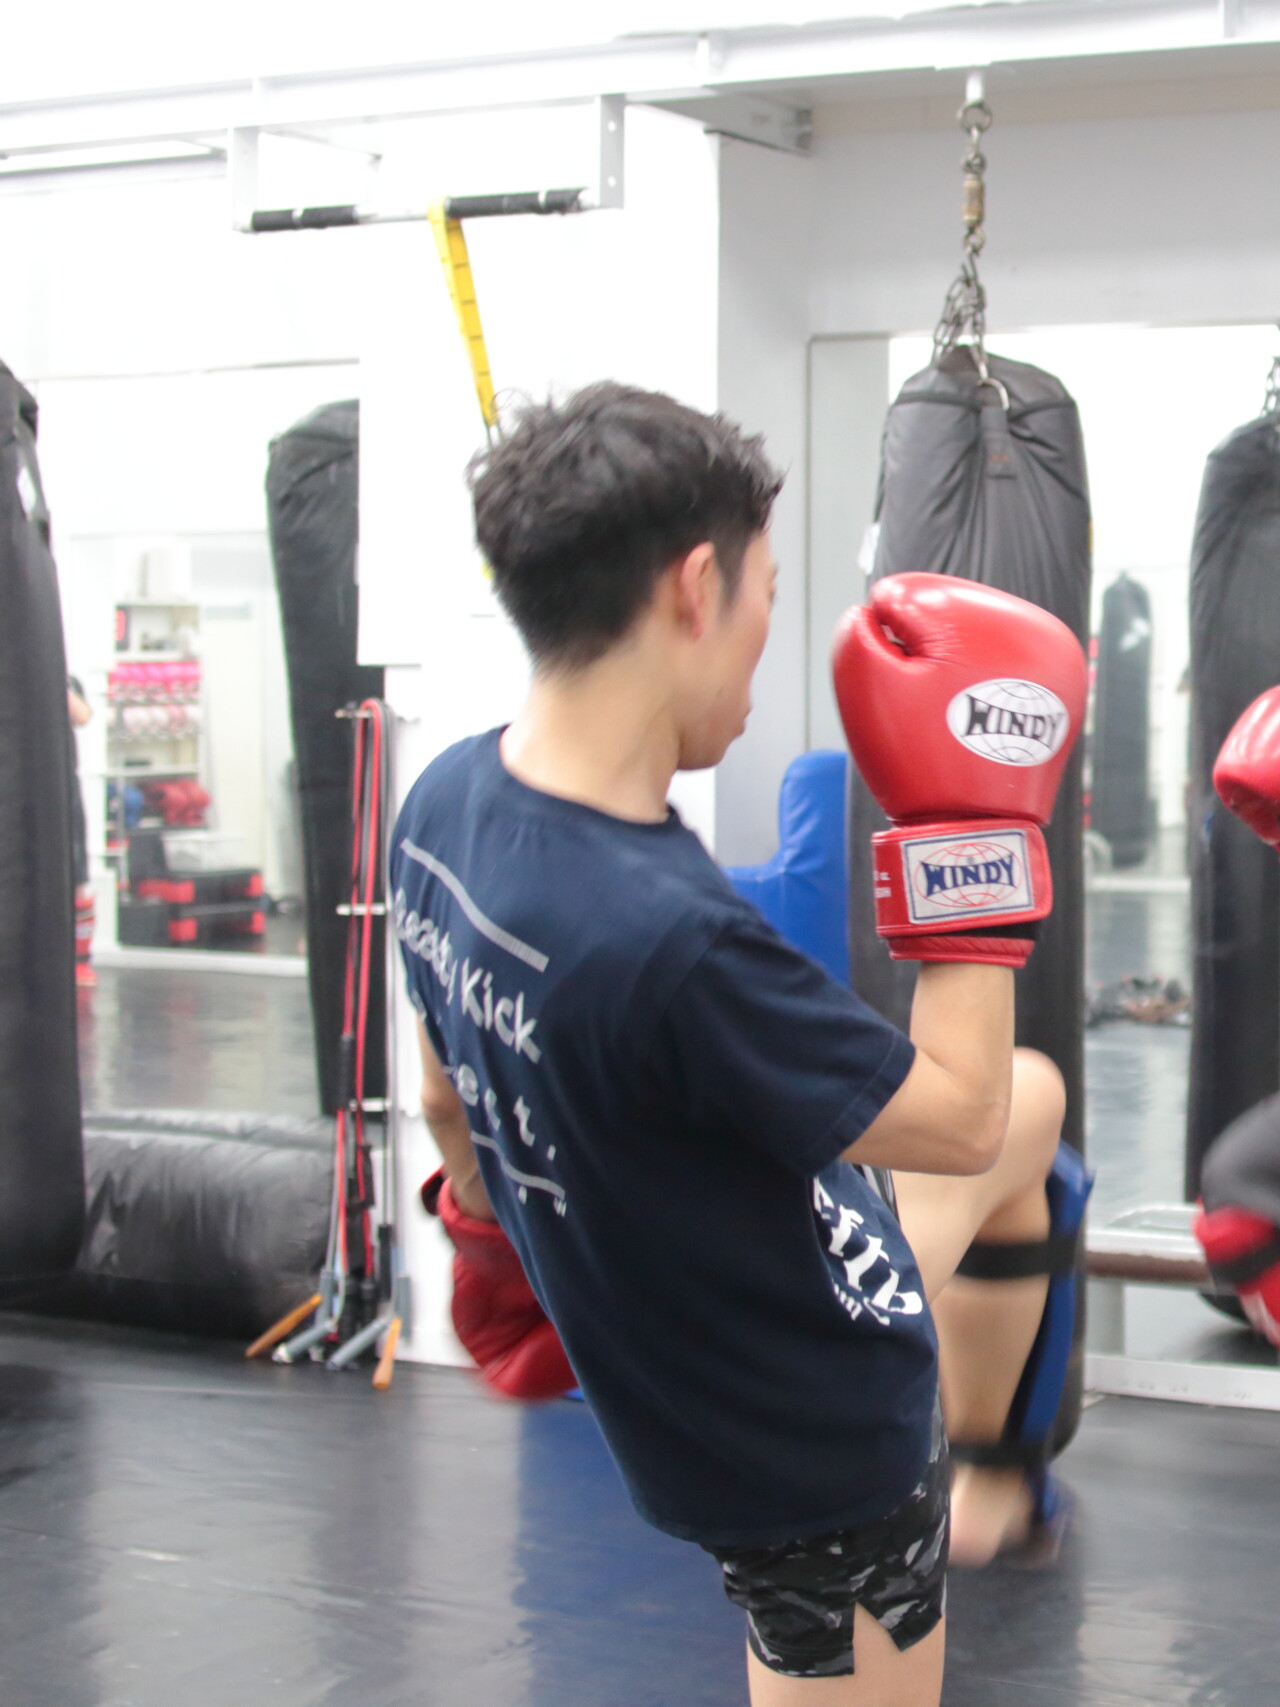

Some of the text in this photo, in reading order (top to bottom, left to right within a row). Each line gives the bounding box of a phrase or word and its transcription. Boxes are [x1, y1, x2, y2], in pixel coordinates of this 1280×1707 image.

[962, 693, 1066, 749] WINDY
[919, 851, 1018, 898] WINDY
[462, 956, 542, 1064] Kick
